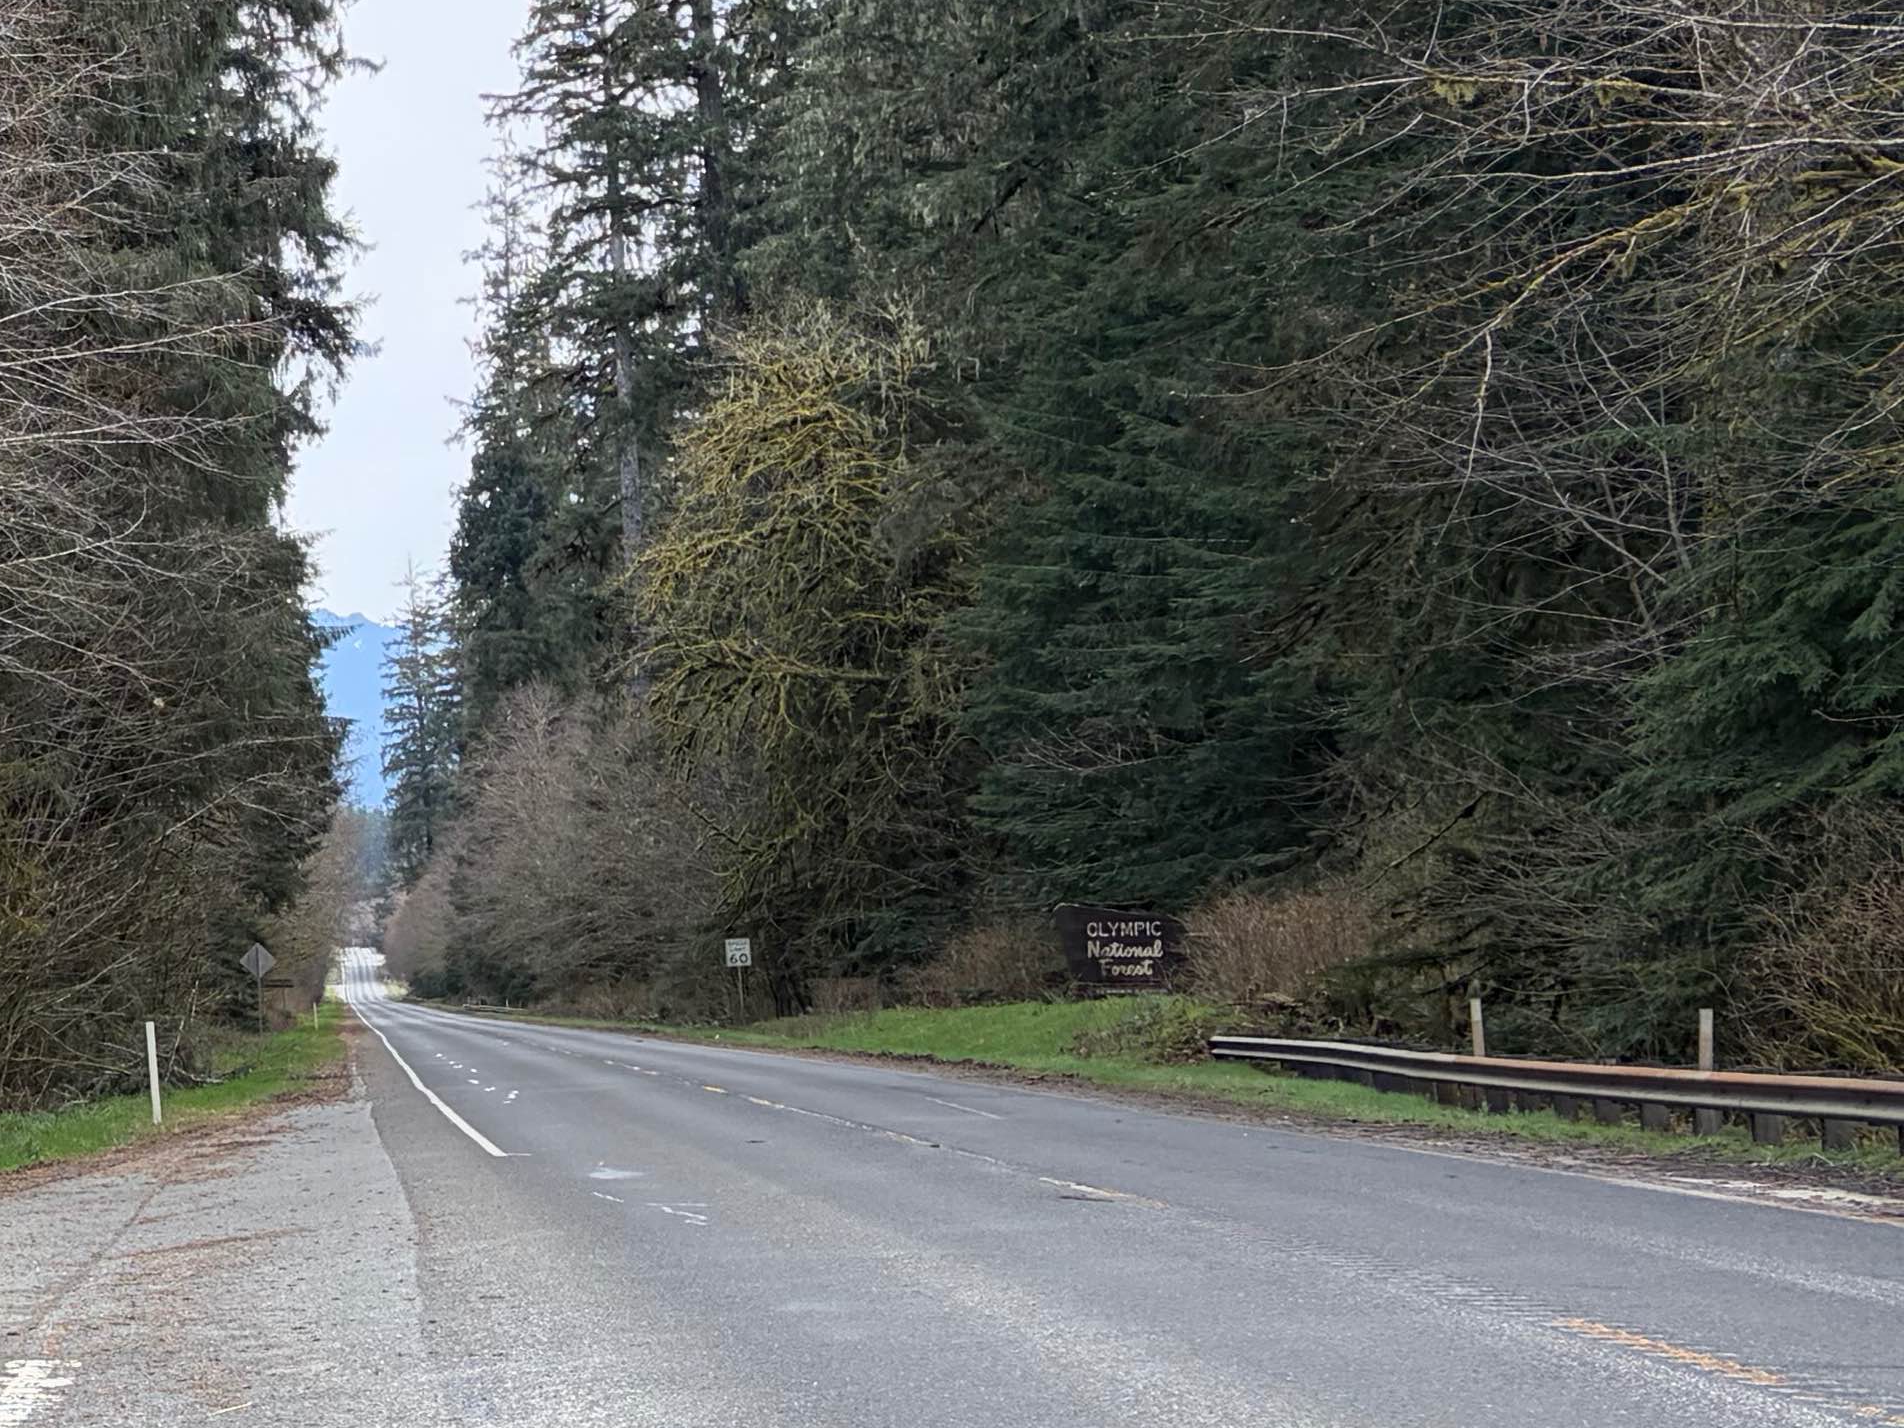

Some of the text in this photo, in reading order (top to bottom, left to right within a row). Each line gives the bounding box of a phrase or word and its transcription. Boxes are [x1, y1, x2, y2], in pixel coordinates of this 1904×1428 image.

[1086, 921, 1162, 938] OLYMPIC
[1086, 939, 1164, 959] National
[730, 953, 748, 964] 60
[1098, 958, 1154, 977] Forest
